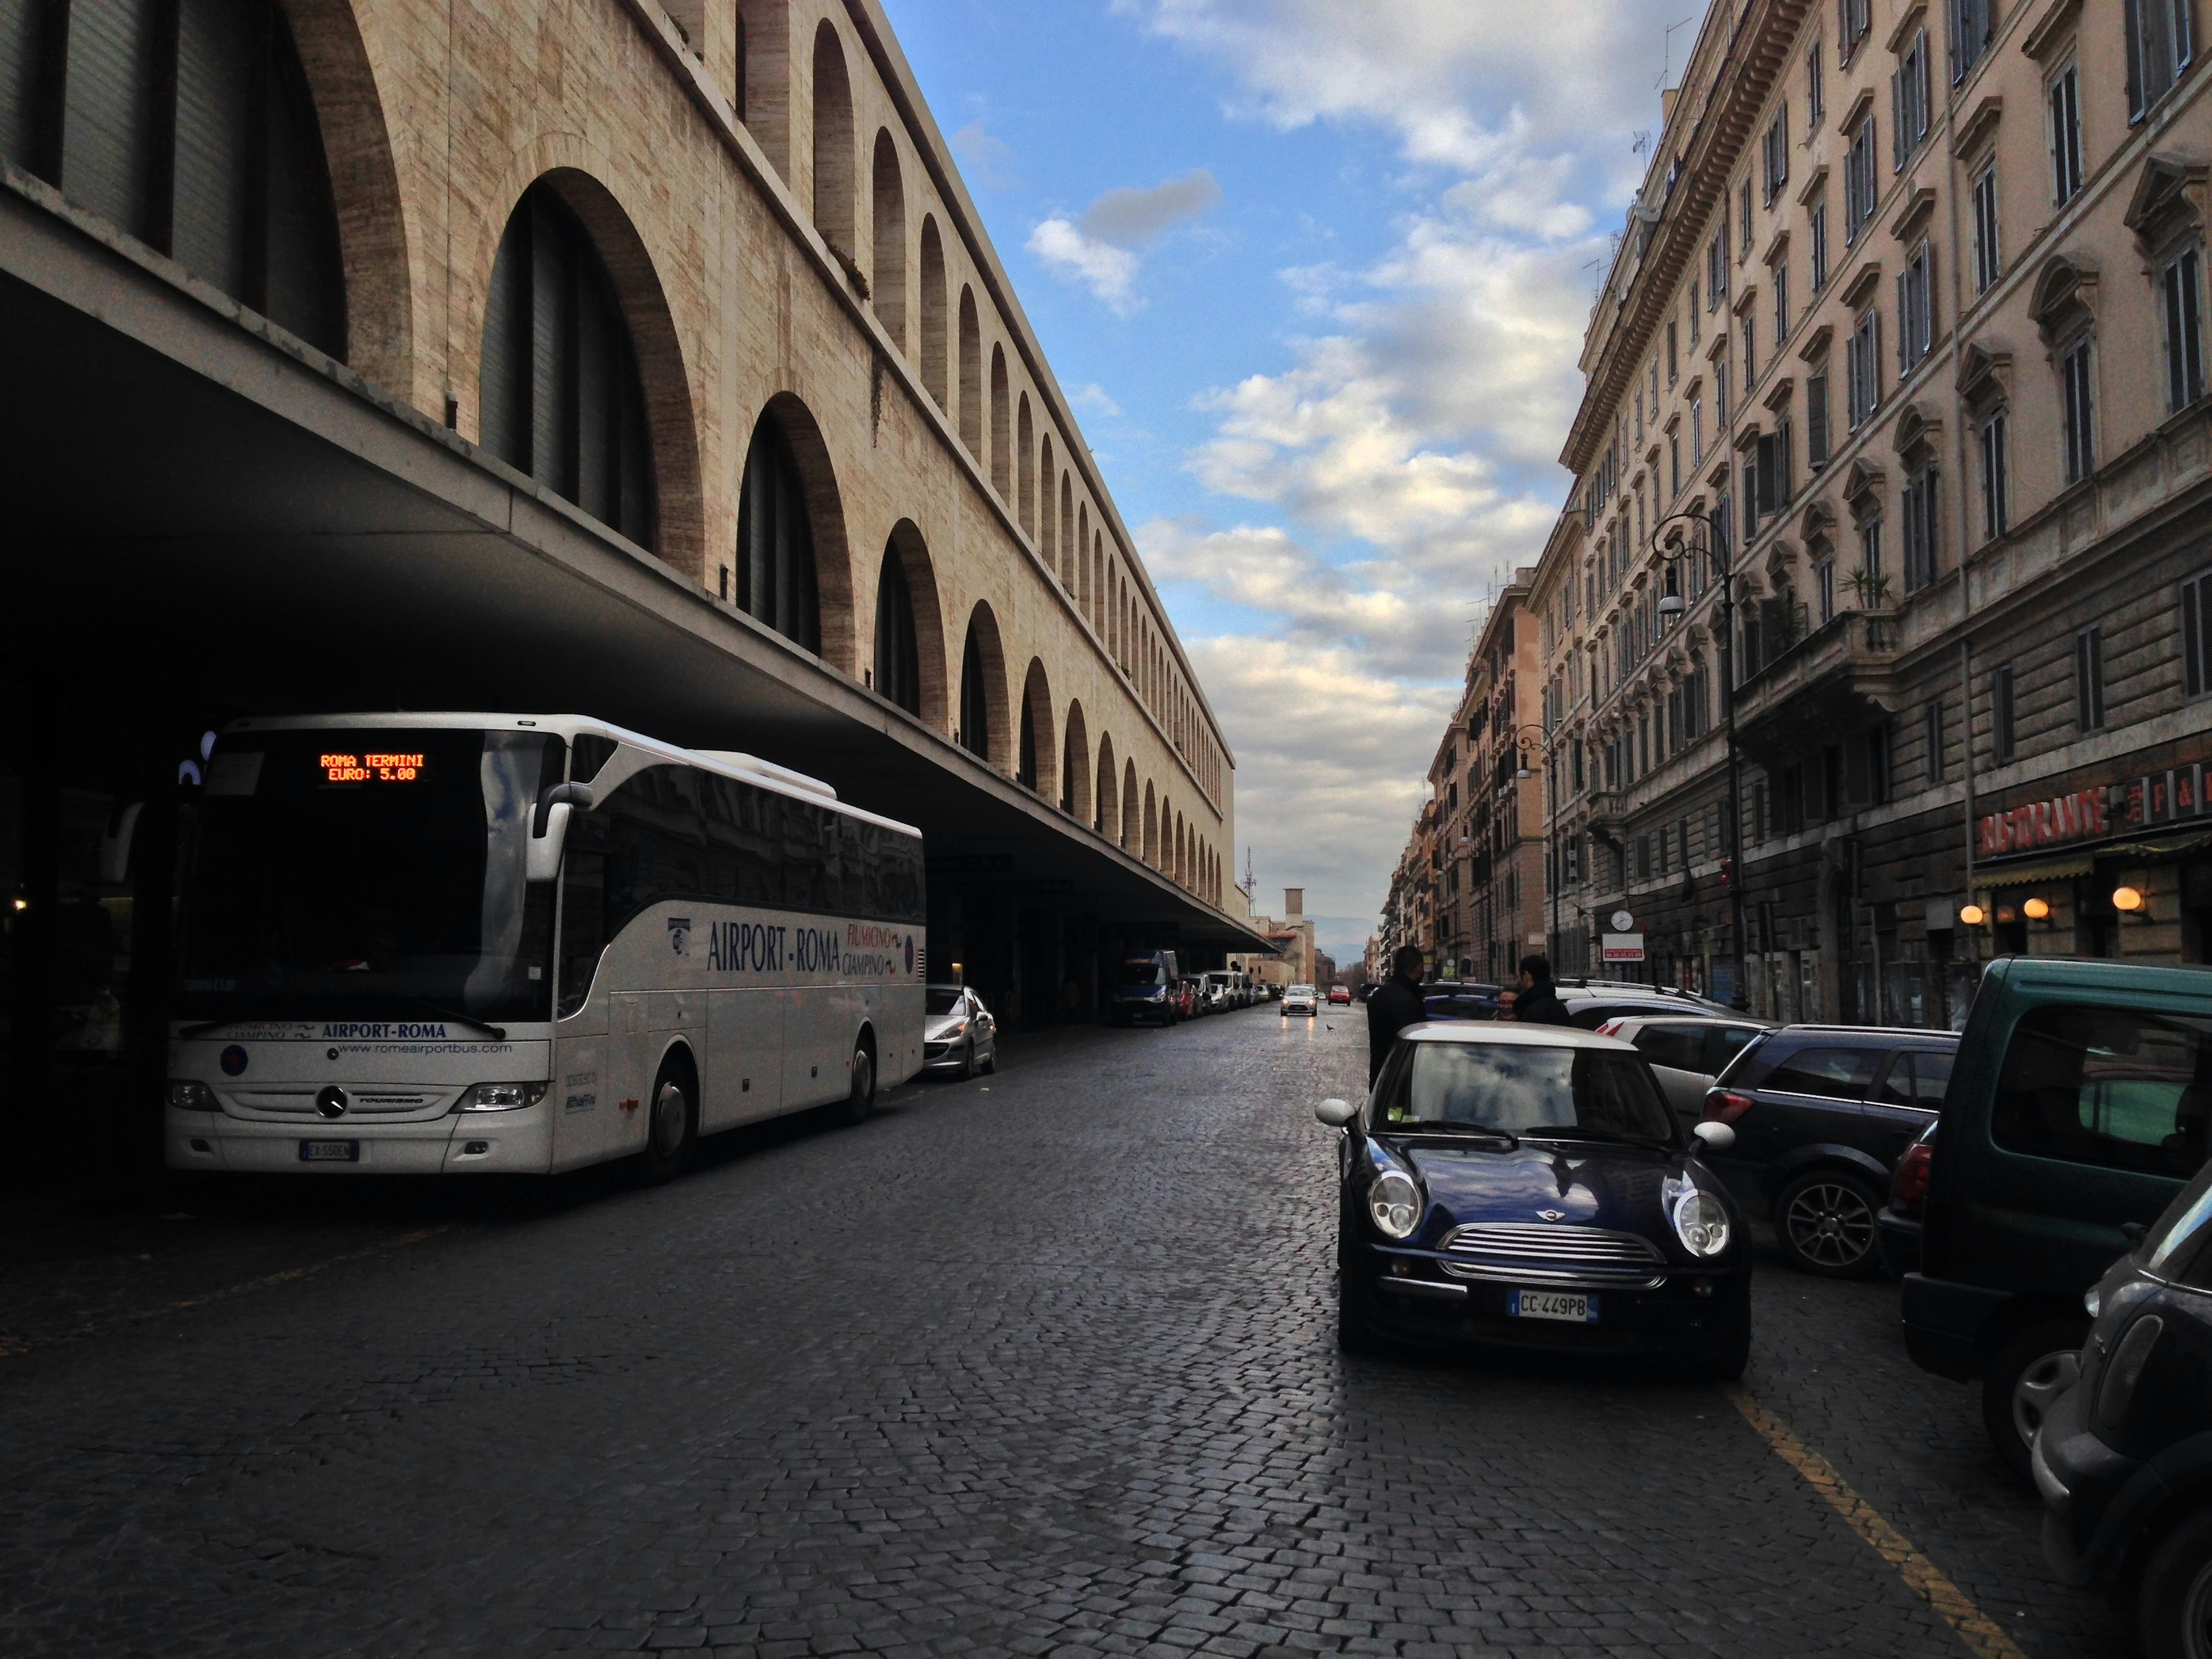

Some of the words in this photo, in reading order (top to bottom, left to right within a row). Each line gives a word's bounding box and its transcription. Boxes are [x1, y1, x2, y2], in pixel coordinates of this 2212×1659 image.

[321, 755, 356, 768] ROMA
[365, 754, 424, 767] TERMINI
[328, 768, 371, 781] EURO:
[380, 768, 415, 781] 5.00
[1980, 786, 2109, 855] RISTORANTE
[847, 923, 891, 949] FIUMICINO
[842, 952, 884, 976] CIAMPINO
[227, 1031, 285, 1040] CIAMPINO
[338, 1043, 512, 1054] www.romeairportbus.com
